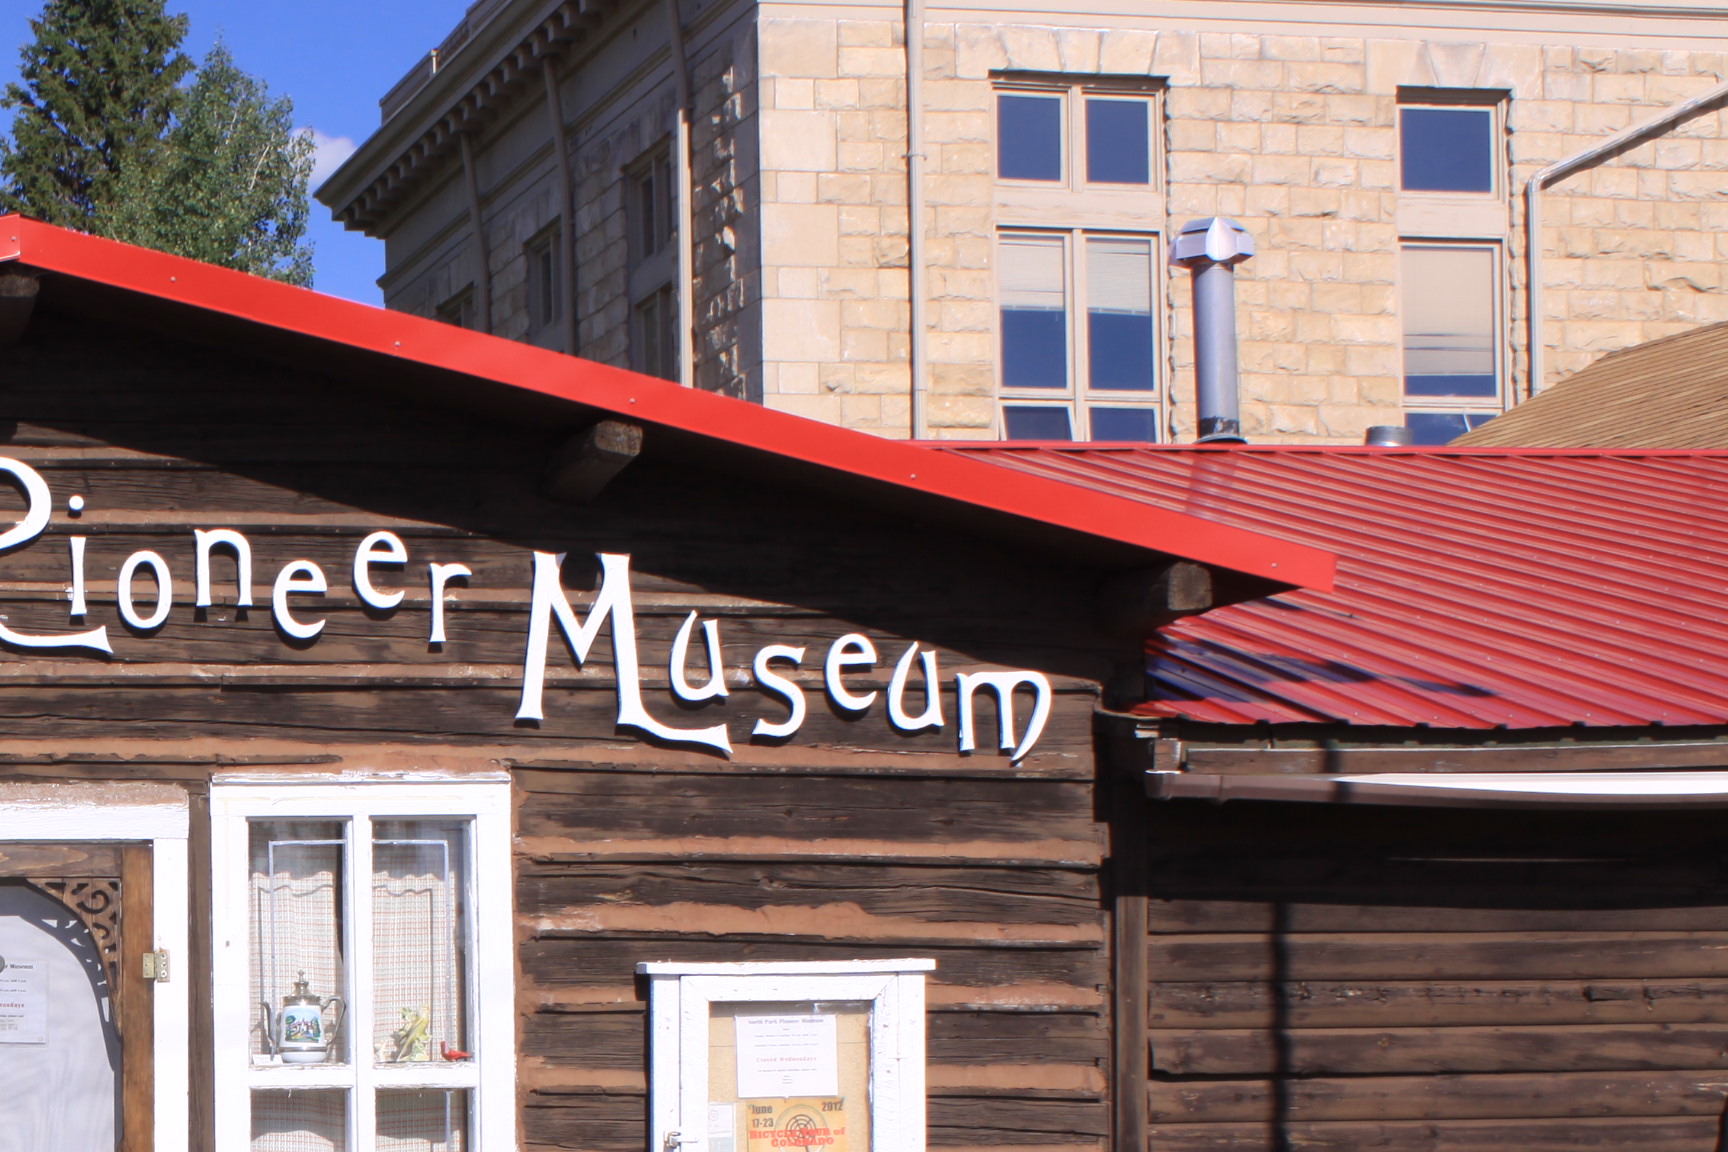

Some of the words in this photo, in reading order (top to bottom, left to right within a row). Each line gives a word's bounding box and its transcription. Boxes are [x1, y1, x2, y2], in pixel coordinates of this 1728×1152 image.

[515, 552, 1050, 762] Museum
[821, 1101, 843, 1112] 2012
[751, 1117, 774, 1128] 17-23
